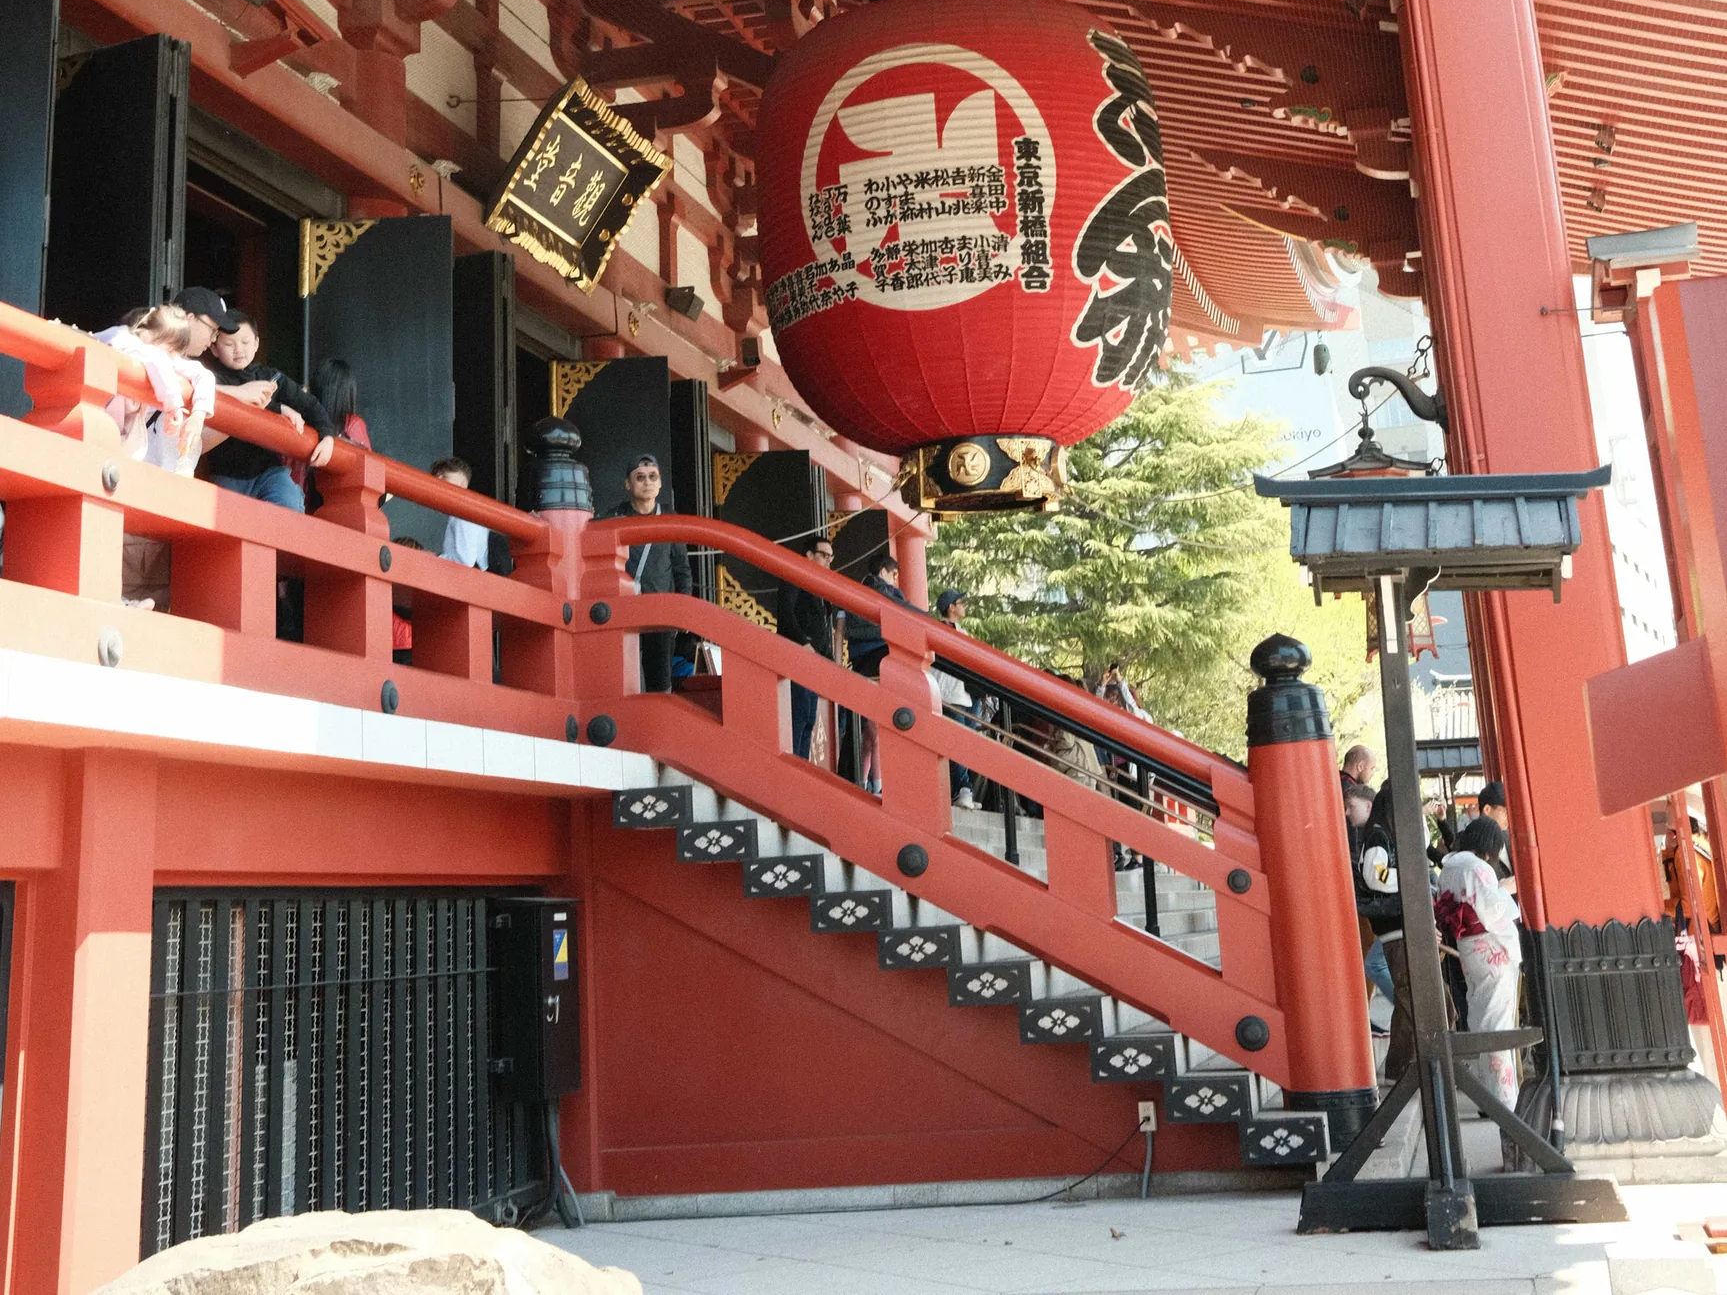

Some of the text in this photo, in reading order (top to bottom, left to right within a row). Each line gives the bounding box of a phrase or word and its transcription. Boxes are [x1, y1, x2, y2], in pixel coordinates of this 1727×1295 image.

[914, 172, 933, 220] 米村
[931, 169, 951, 216] 松山
[950, 168, 971, 215] 吉兆
[986, 165, 1007, 214] 金田中
[1014, 137, 1050, 290] 東京新橋組合
[828, 257, 846, 301] あや
[841, 252, 860, 299] 晶子
[938, 236, 958, 285] 杏子
